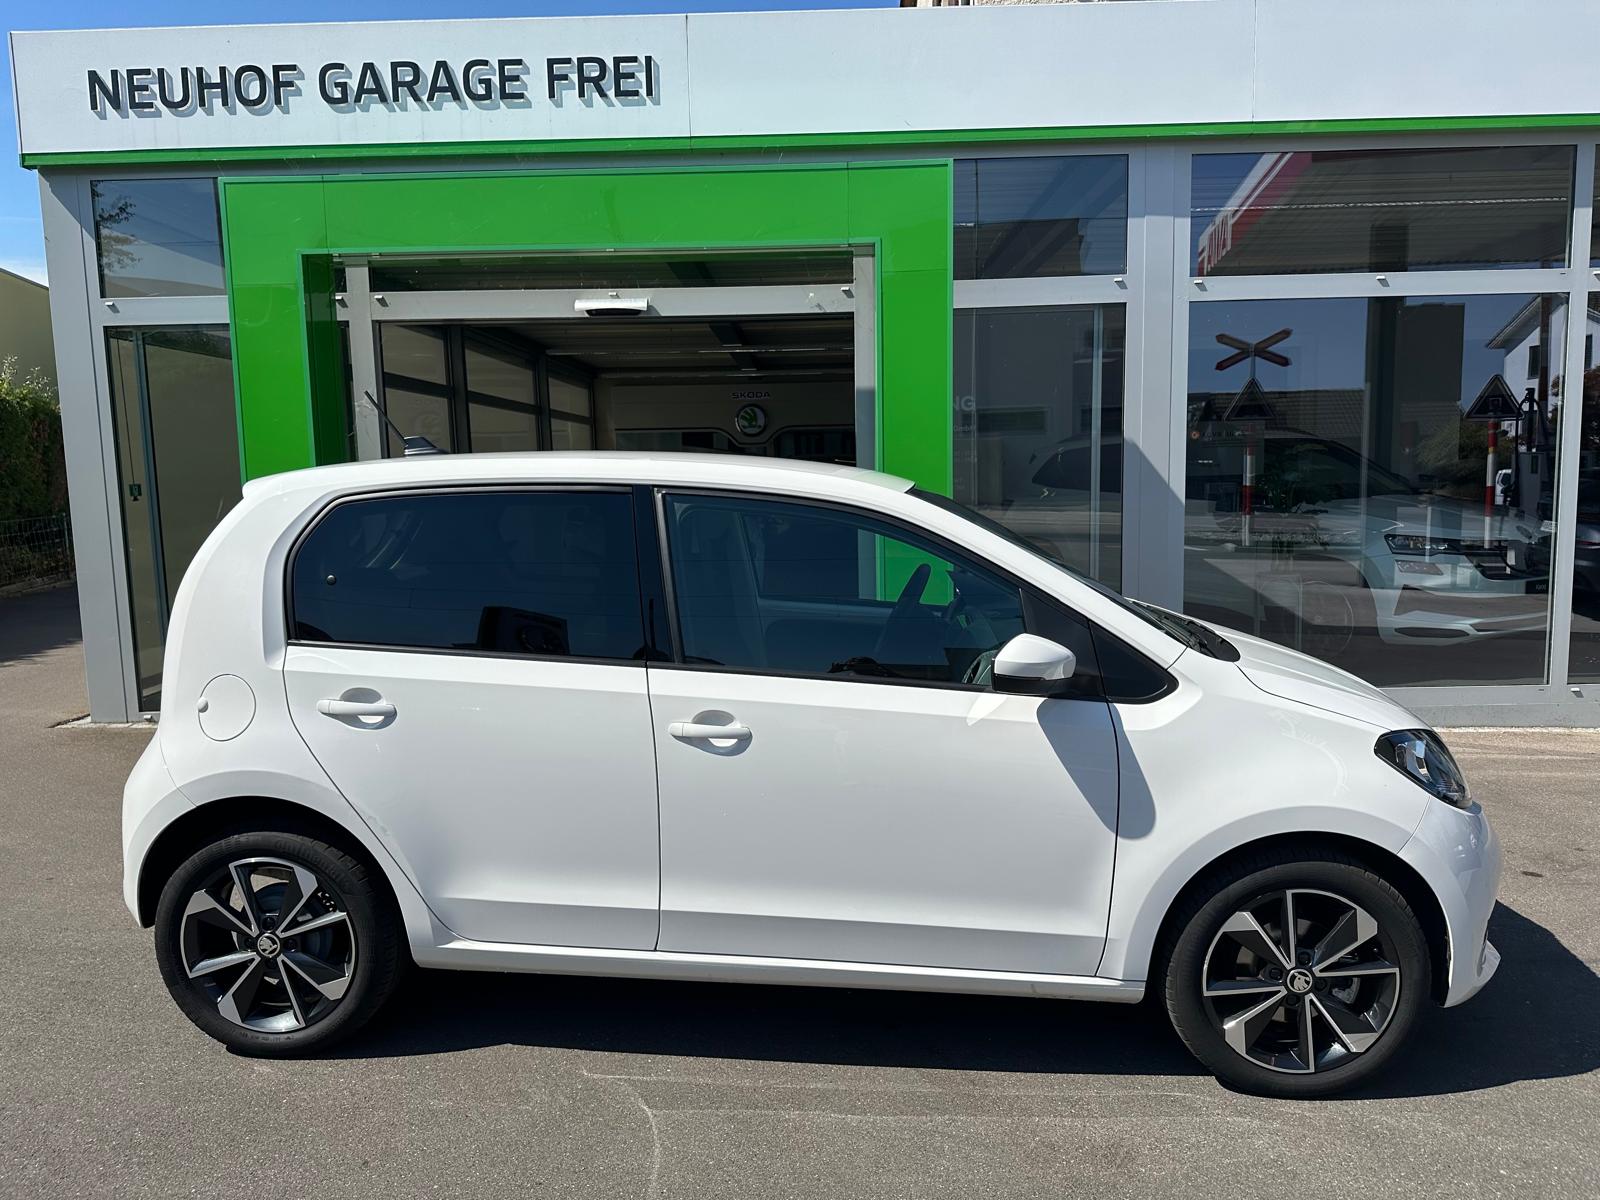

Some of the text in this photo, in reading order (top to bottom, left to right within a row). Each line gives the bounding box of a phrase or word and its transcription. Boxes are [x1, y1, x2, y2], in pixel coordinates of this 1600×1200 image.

[87, 55, 653, 111] NEUHOF GARAGE FREI
